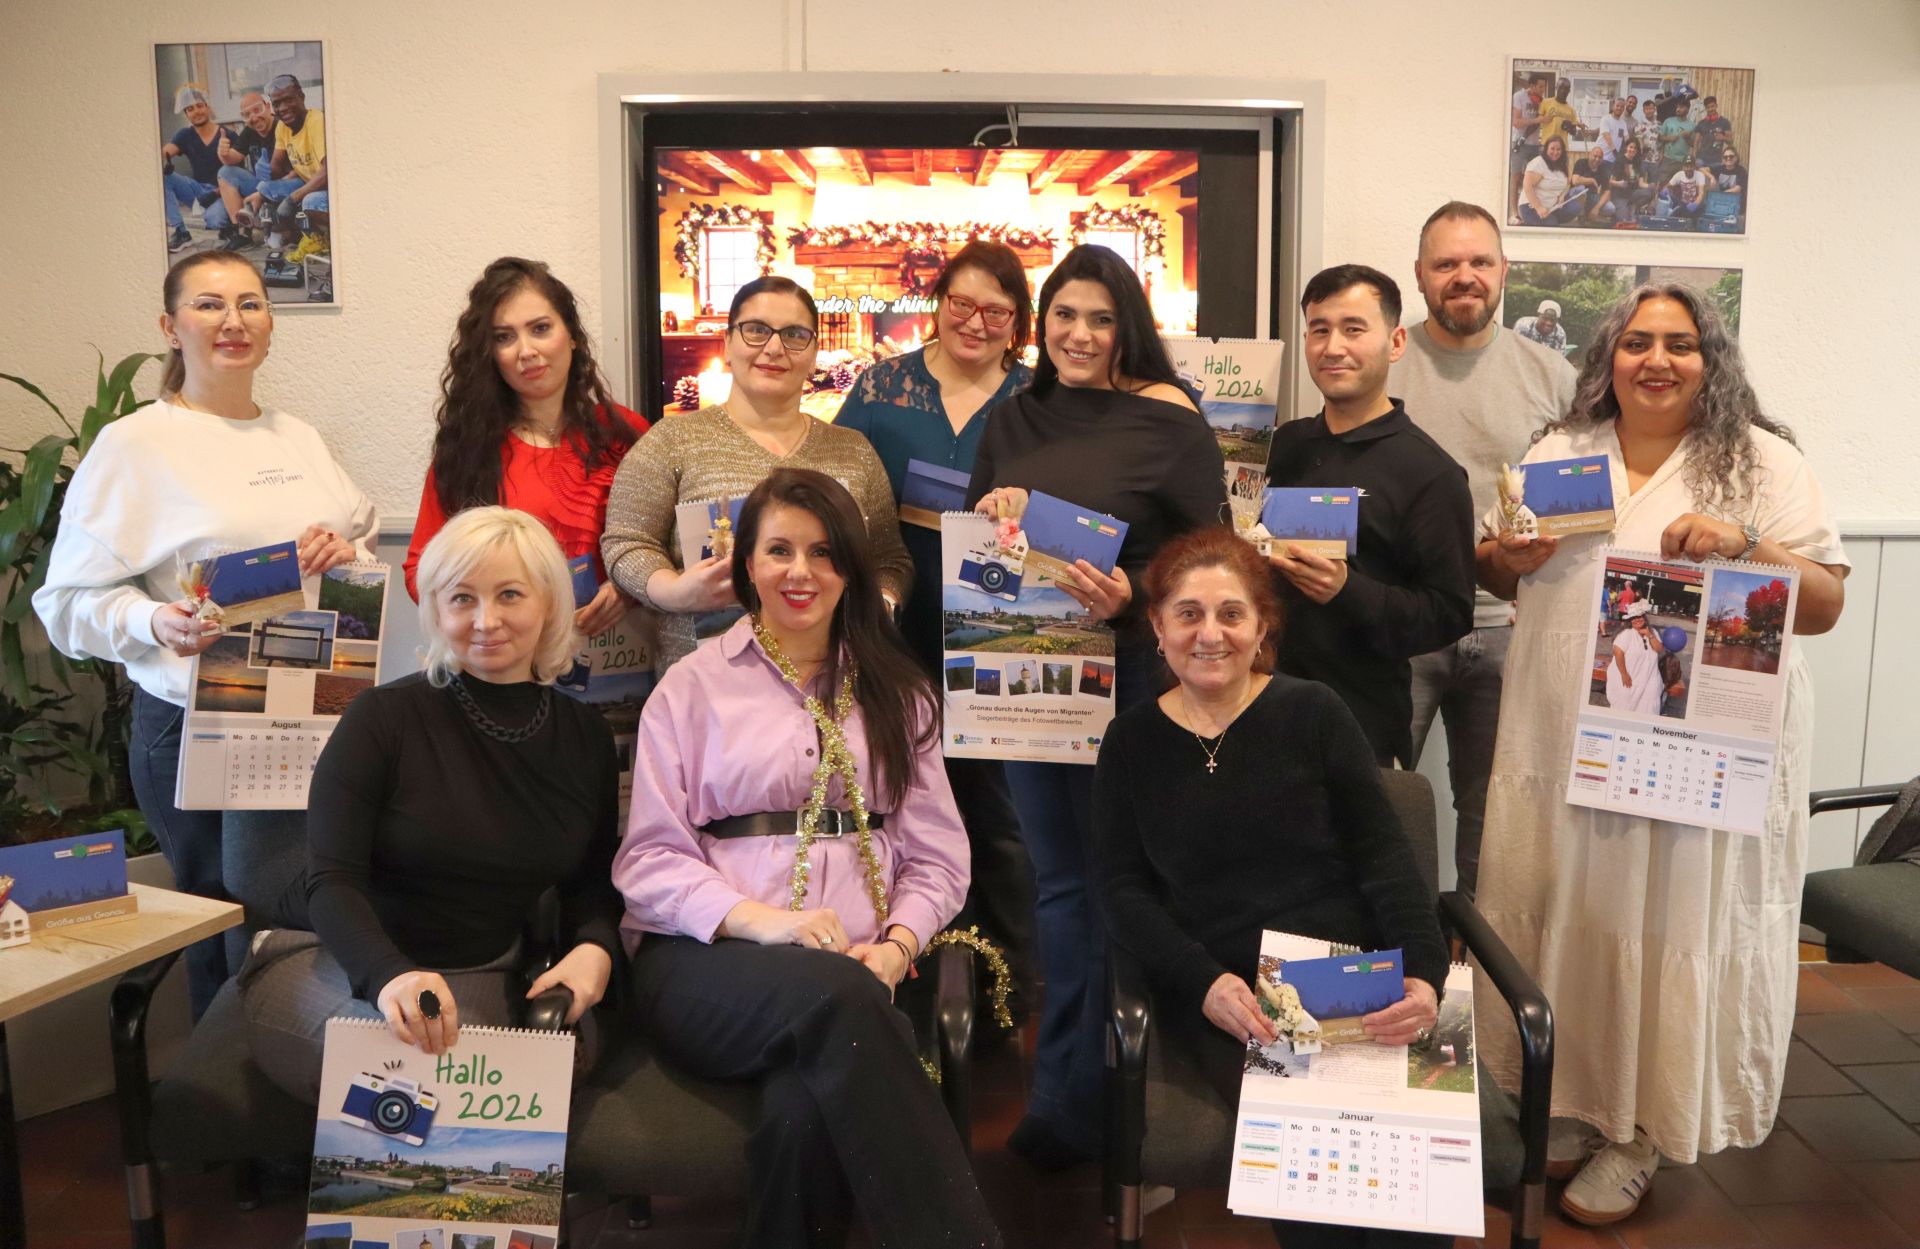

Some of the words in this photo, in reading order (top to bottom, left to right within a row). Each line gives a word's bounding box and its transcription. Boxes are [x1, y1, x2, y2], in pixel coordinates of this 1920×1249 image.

[814, 294, 855, 313] nder
[858, 294, 886, 313] the
[1204, 355, 1242, 376] Hallo
[1215, 378, 1264, 398] 2026
[602, 648, 648, 670] 2026
[271, 720, 302, 730] August
[1652, 726, 1698, 741] November
[435, 1053, 503, 1086] Hallo
[457, 1091, 543, 1122] 2026
[1338, 1112, 1374, 1122] Januar
[1328, 1188, 1336, 1196] 28
[1368, 1178, 1378, 1186] 23
[1388, 1181, 1398, 1189] 24
